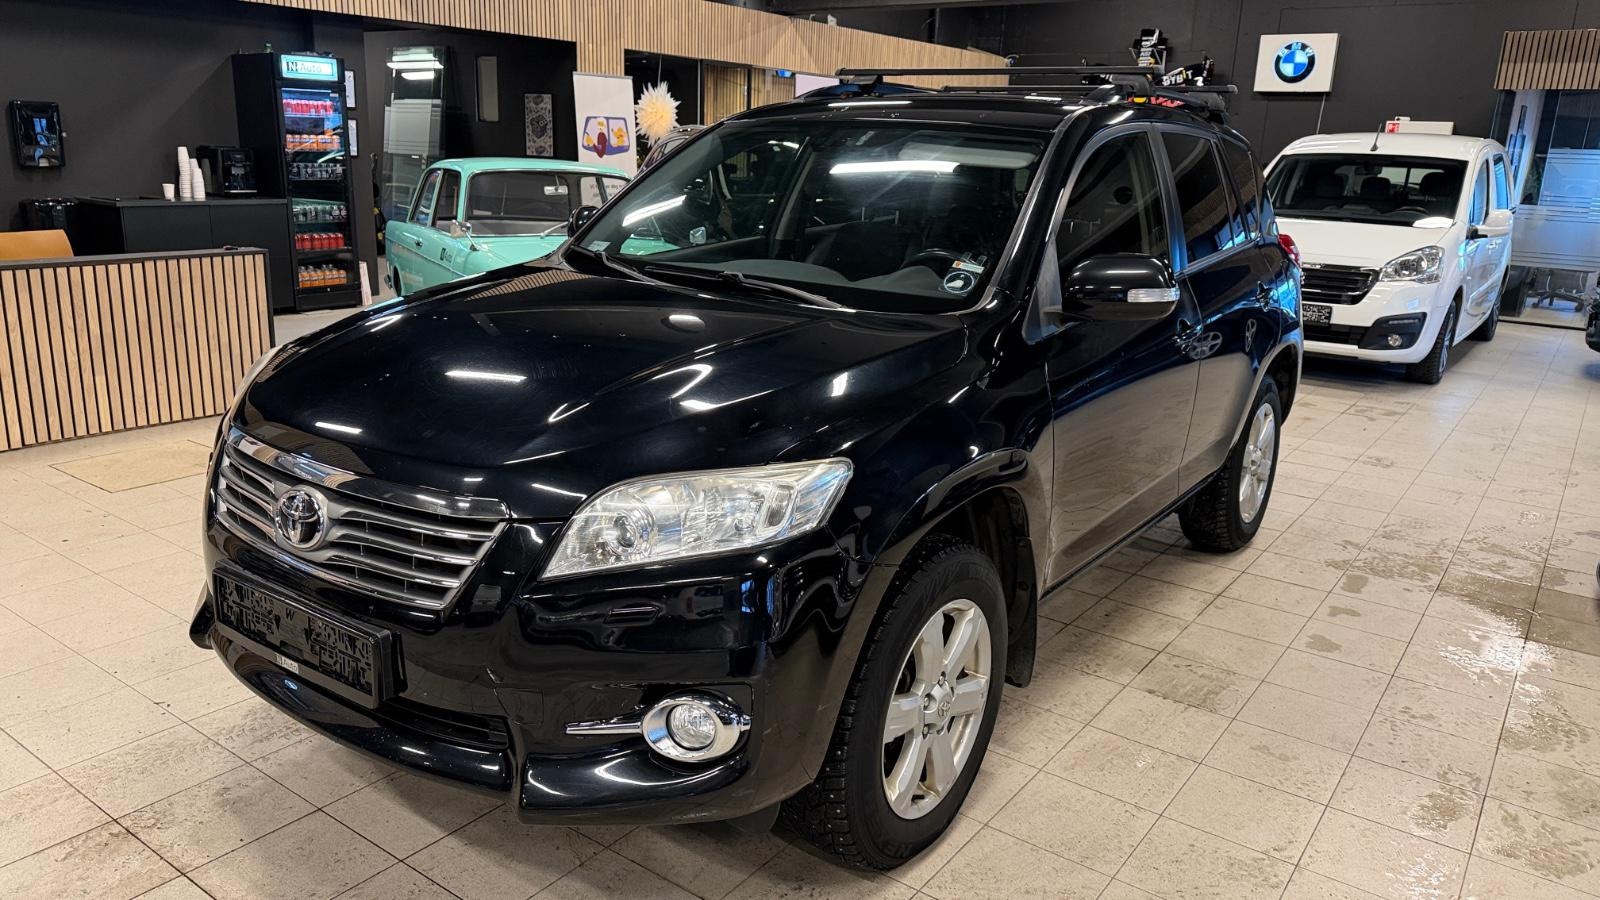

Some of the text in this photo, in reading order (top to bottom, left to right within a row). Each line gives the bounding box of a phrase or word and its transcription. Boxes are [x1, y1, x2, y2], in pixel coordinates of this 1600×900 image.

[1279, 41, 1314, 57] BMW
[300, 62, 322, 73] Auto
[283, 658, 298, 672] Auto
